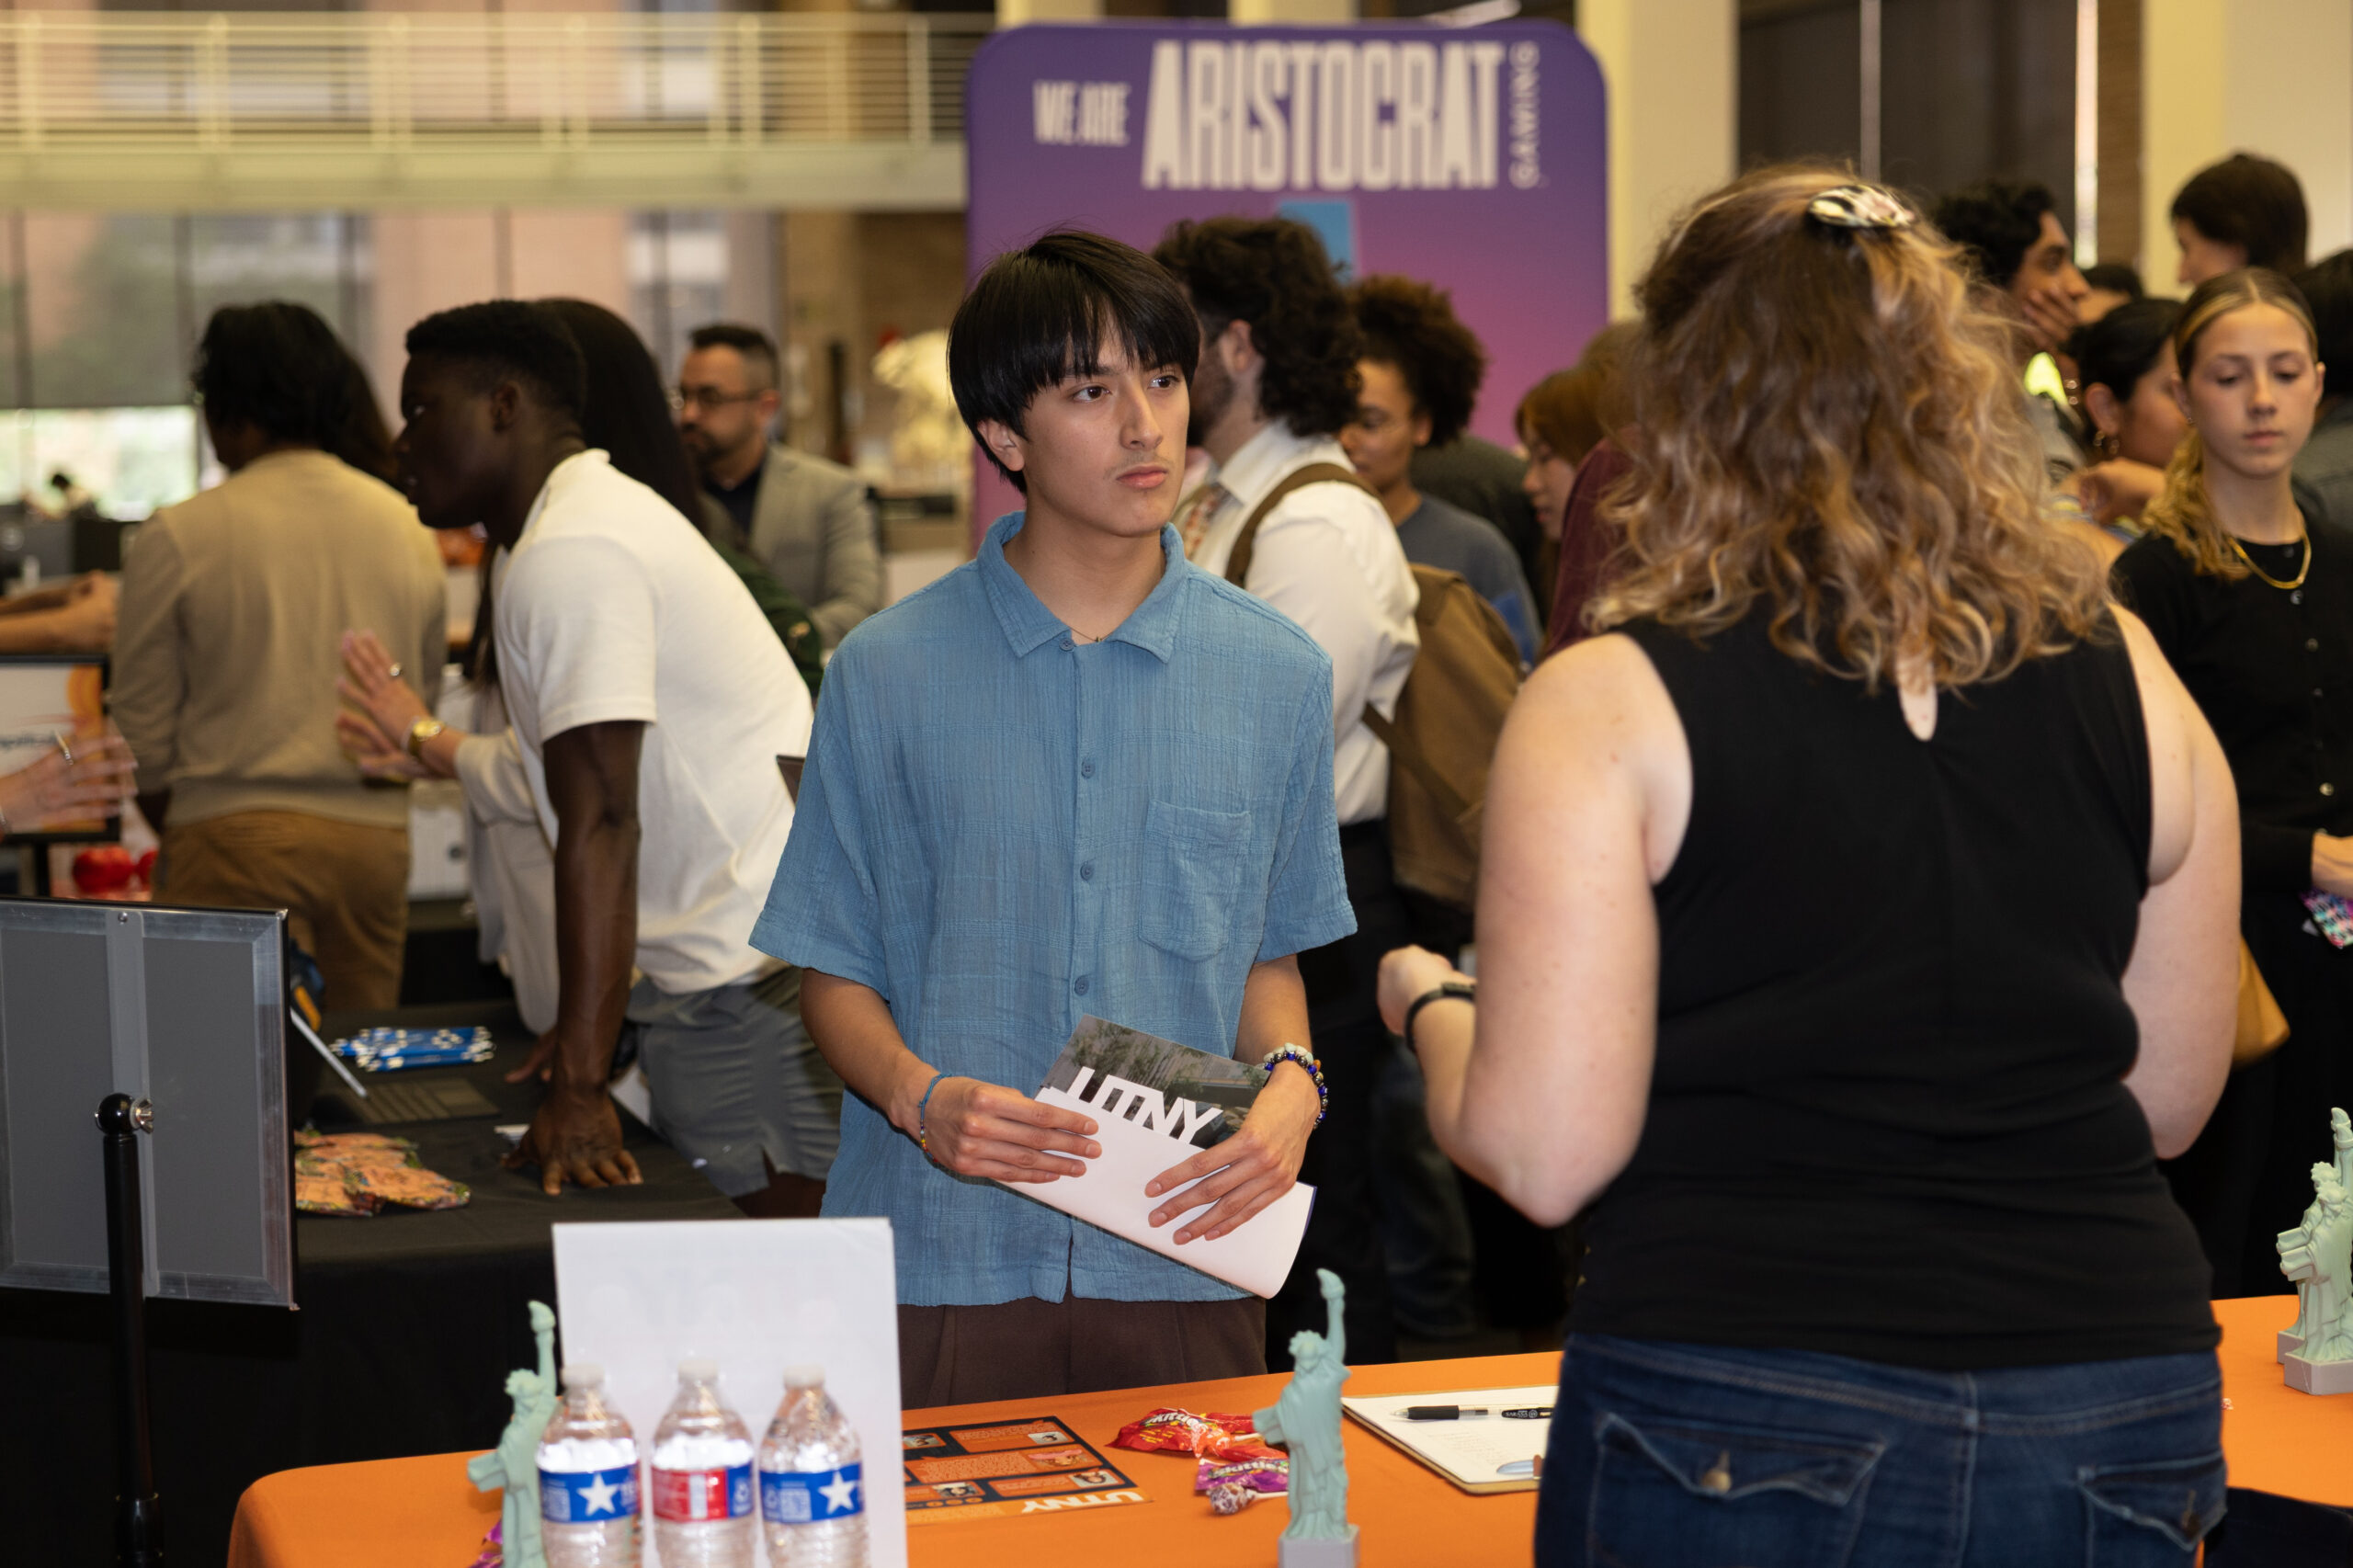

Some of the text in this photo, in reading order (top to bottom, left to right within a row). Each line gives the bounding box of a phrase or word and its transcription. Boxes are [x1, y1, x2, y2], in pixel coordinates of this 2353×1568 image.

[1032, 40, 1505, 190] WE ARE ARISTOCRAT
[1508, 40, 1540, 188] GAMING
[1021, 1491, 1144, 1514] UTNY
